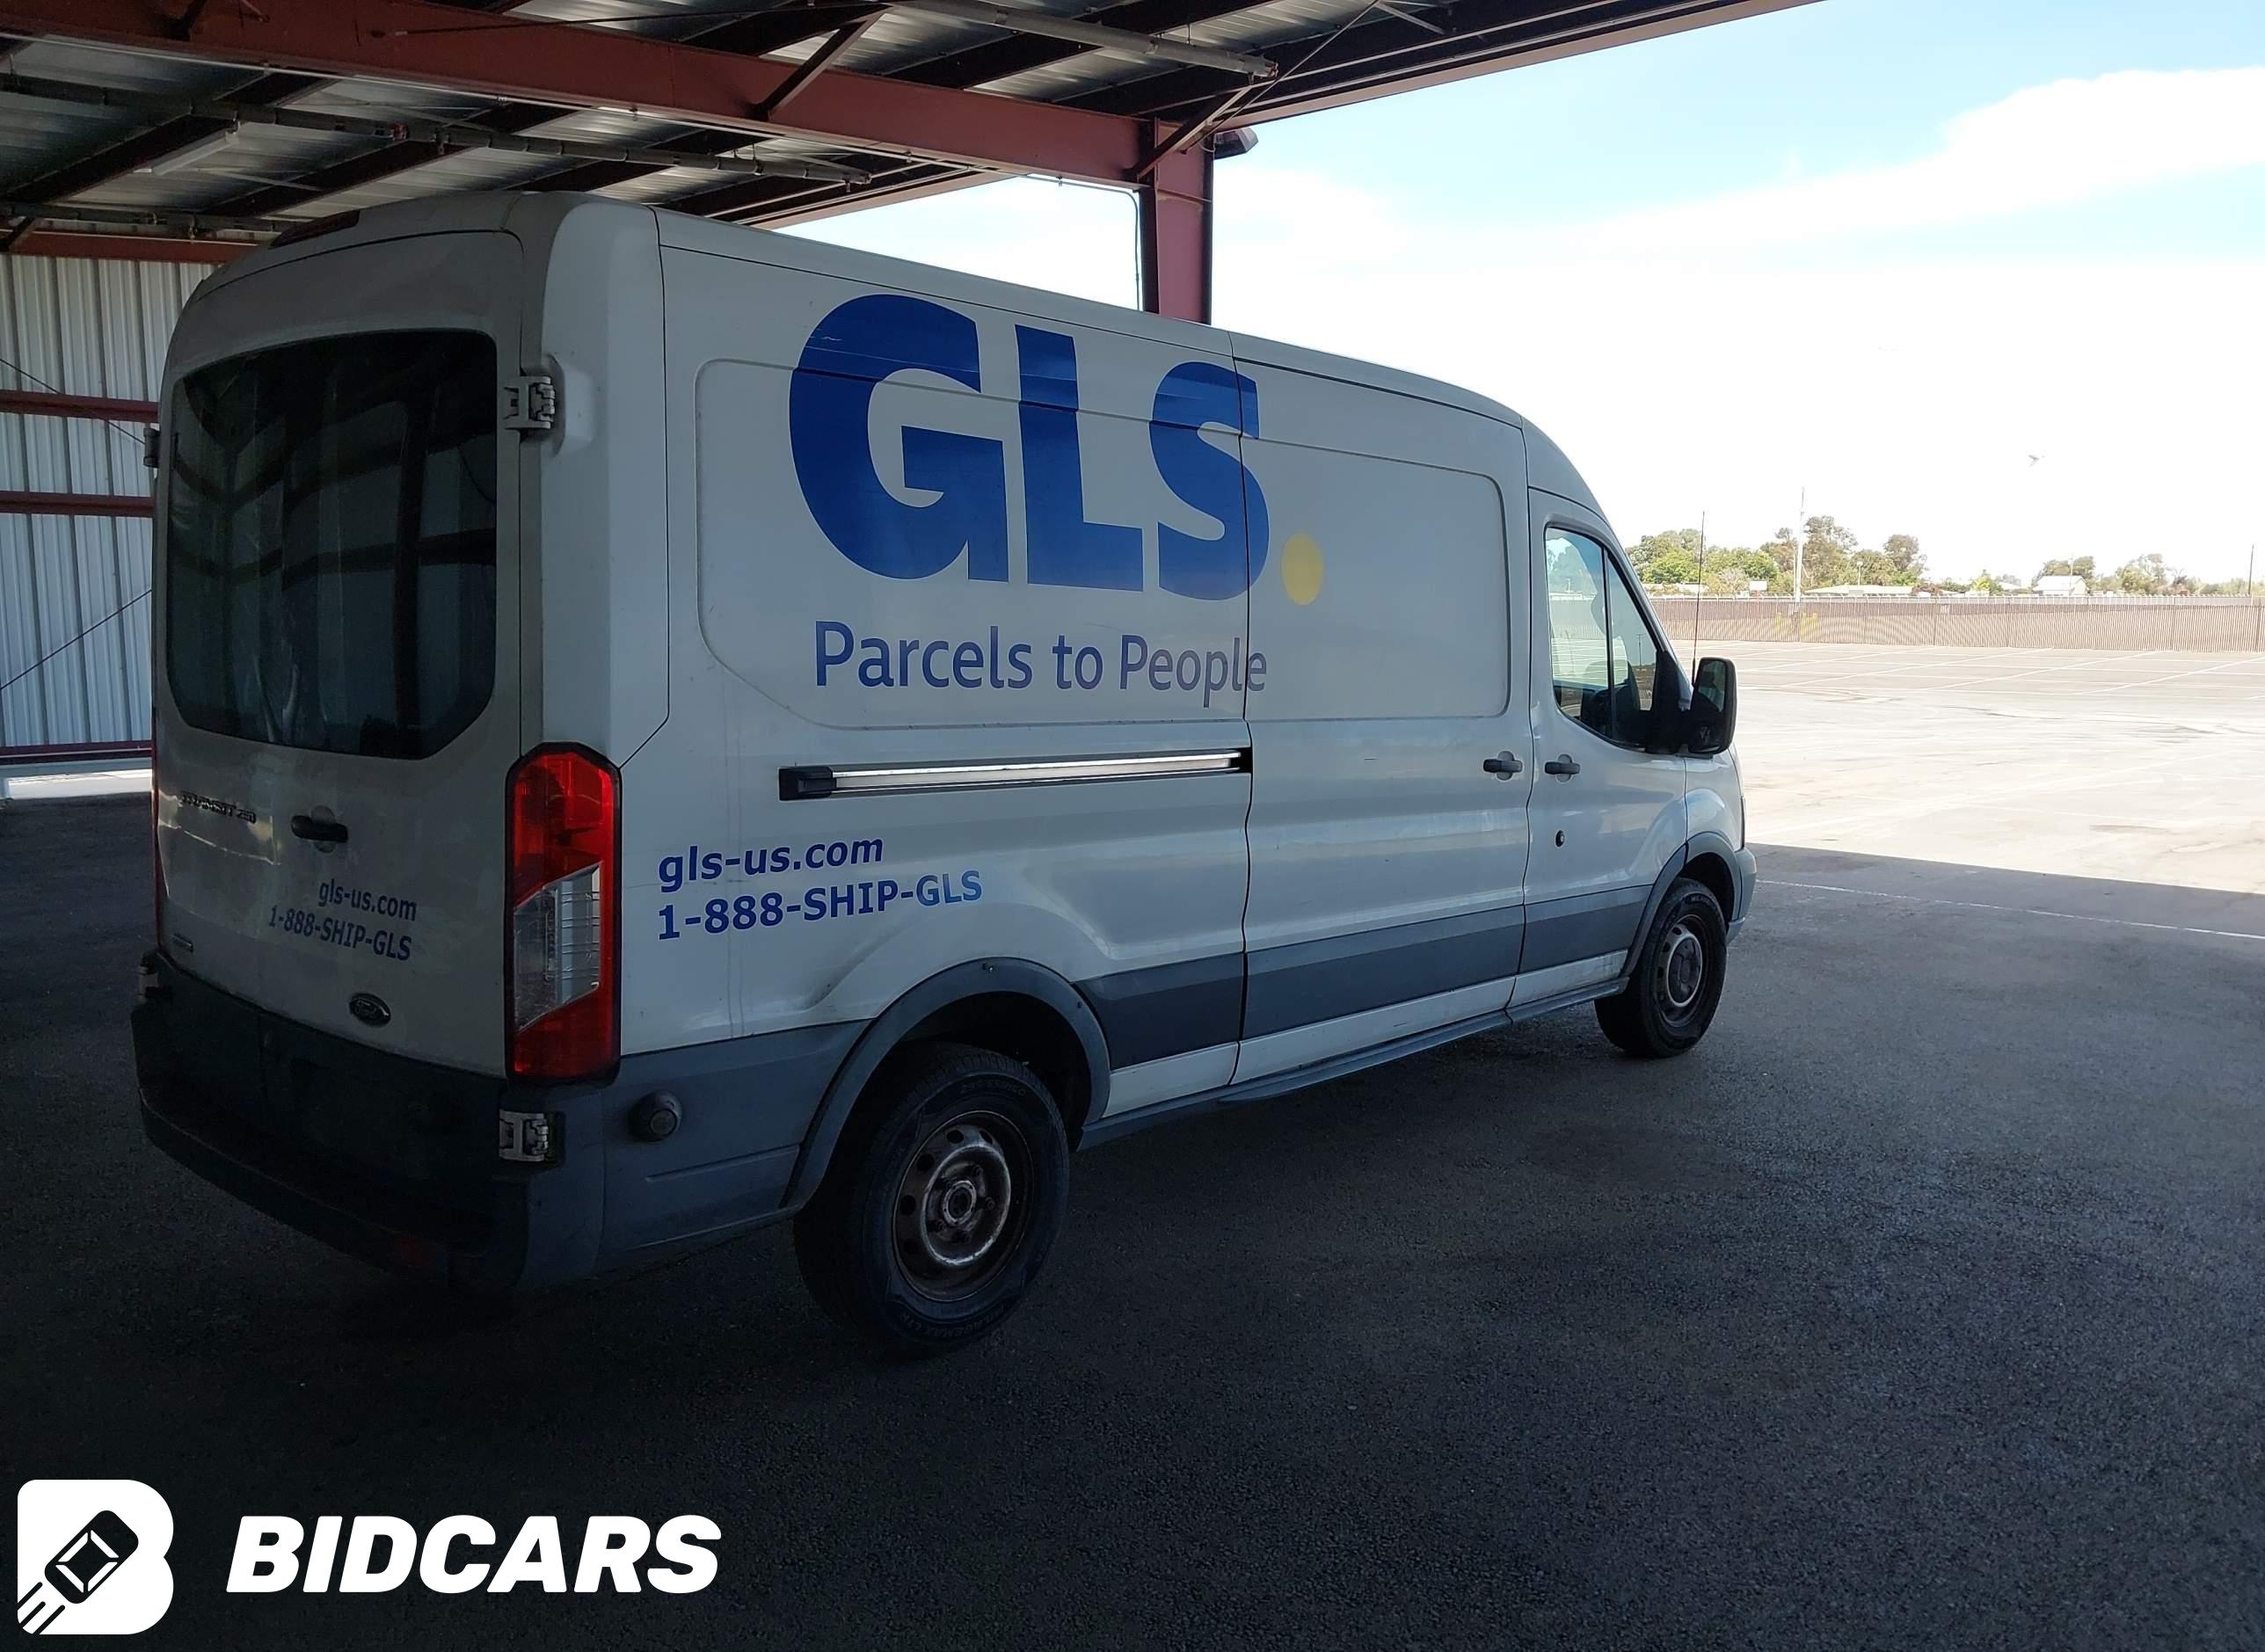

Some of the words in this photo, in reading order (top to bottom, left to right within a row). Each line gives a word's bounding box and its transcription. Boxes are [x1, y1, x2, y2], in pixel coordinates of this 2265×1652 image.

[814, 620, 1033, 689] Parcels
[1052, 633, 1103, 690] to
[1119, 634, 1267, 709] People
[659, 838, 884, 893] gls-us.com
[318, 878, 418, 921] gls-us.com
[658, 870, 983, 940] 1-888-SHIP-GLS
[267, 905, 412, 961] 1-888-SHIP-GLS
